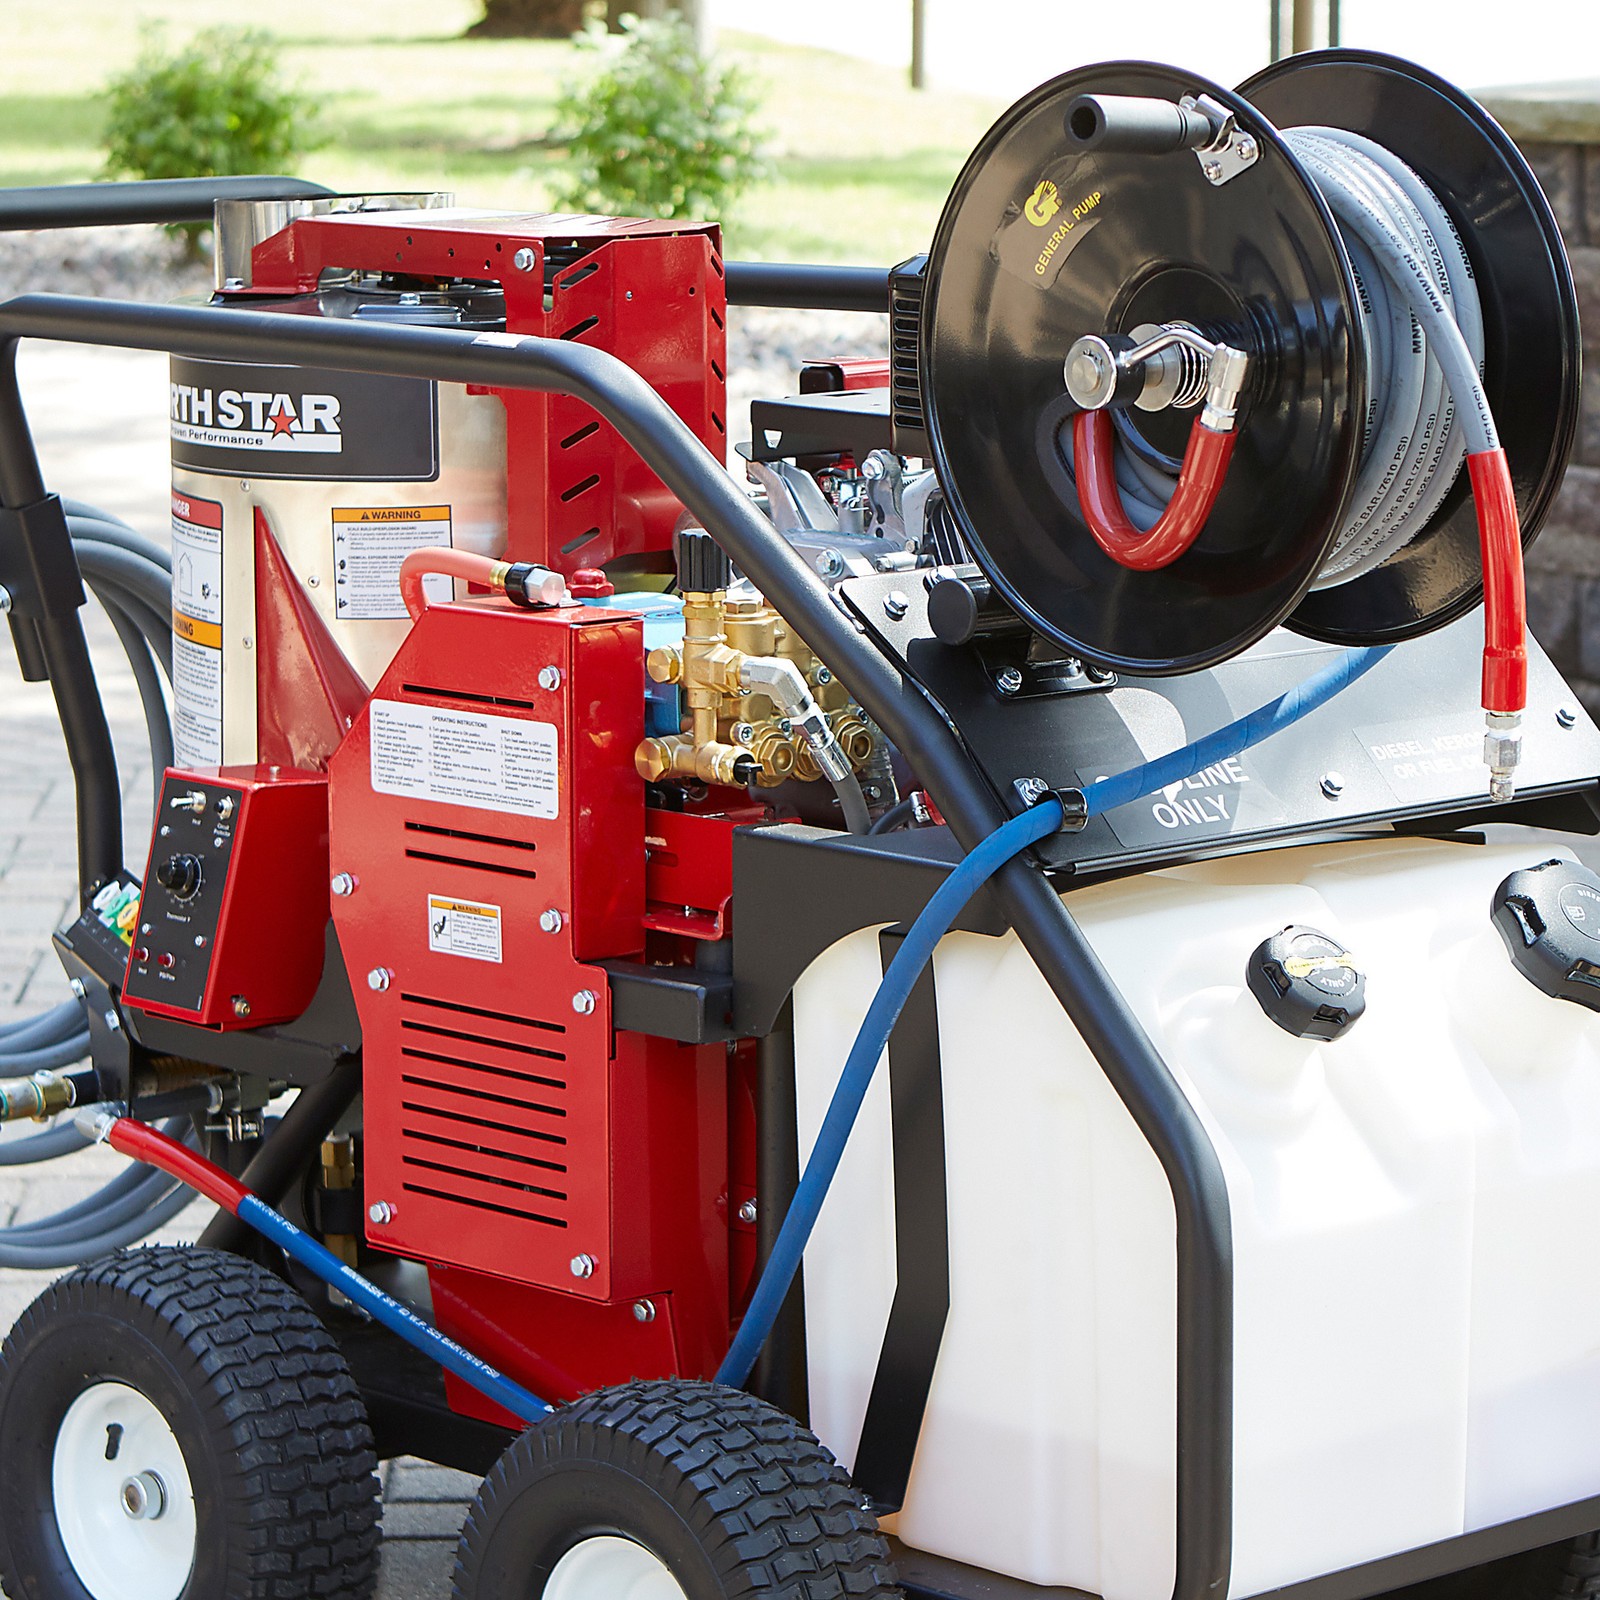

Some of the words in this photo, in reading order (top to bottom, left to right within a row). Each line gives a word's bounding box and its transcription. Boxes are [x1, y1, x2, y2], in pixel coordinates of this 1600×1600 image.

[1035, 220, 1075, 276] GENERAL
[1071, 191, 1101, 220] PUMP
[1421, 228, 1451, 296] MNWASH
[1404, 253, 1443, 313] MNWASH
[217, 390, 341, 433] STAR
[1367, 398, 1378, 425] PSI)
[1471, 385, 1485, 411] PSI)
[188, 429, 263, 446] Performance
[1480, 413, 1497, 449] (7610
[1396, 477, 1415, 503] BAR
[1411, 442, 1429, 476] (7610
[1424, 412, 1437, 441] PSI)
[1416, 476, 1431, 496] 525
[1427, 445, 1444, 473] BAR
[1440, 407, 1454, 444] (7610
[1344, 521, 1362, 539] 525
[1360, 495, 1381, 521] BAR
[1377, 463, 1399, 496] (7610
[1394, 435, 1410, 462] PSI)
[371, 510, 421, 520] WARNING
[431, 715, 455, 723] OPERATING
[456, 718, 487, 728] INSTRUCTIONS
[1151, 793, 1231, 829] ONLY
[457, 904, 482, 915] WARNING
